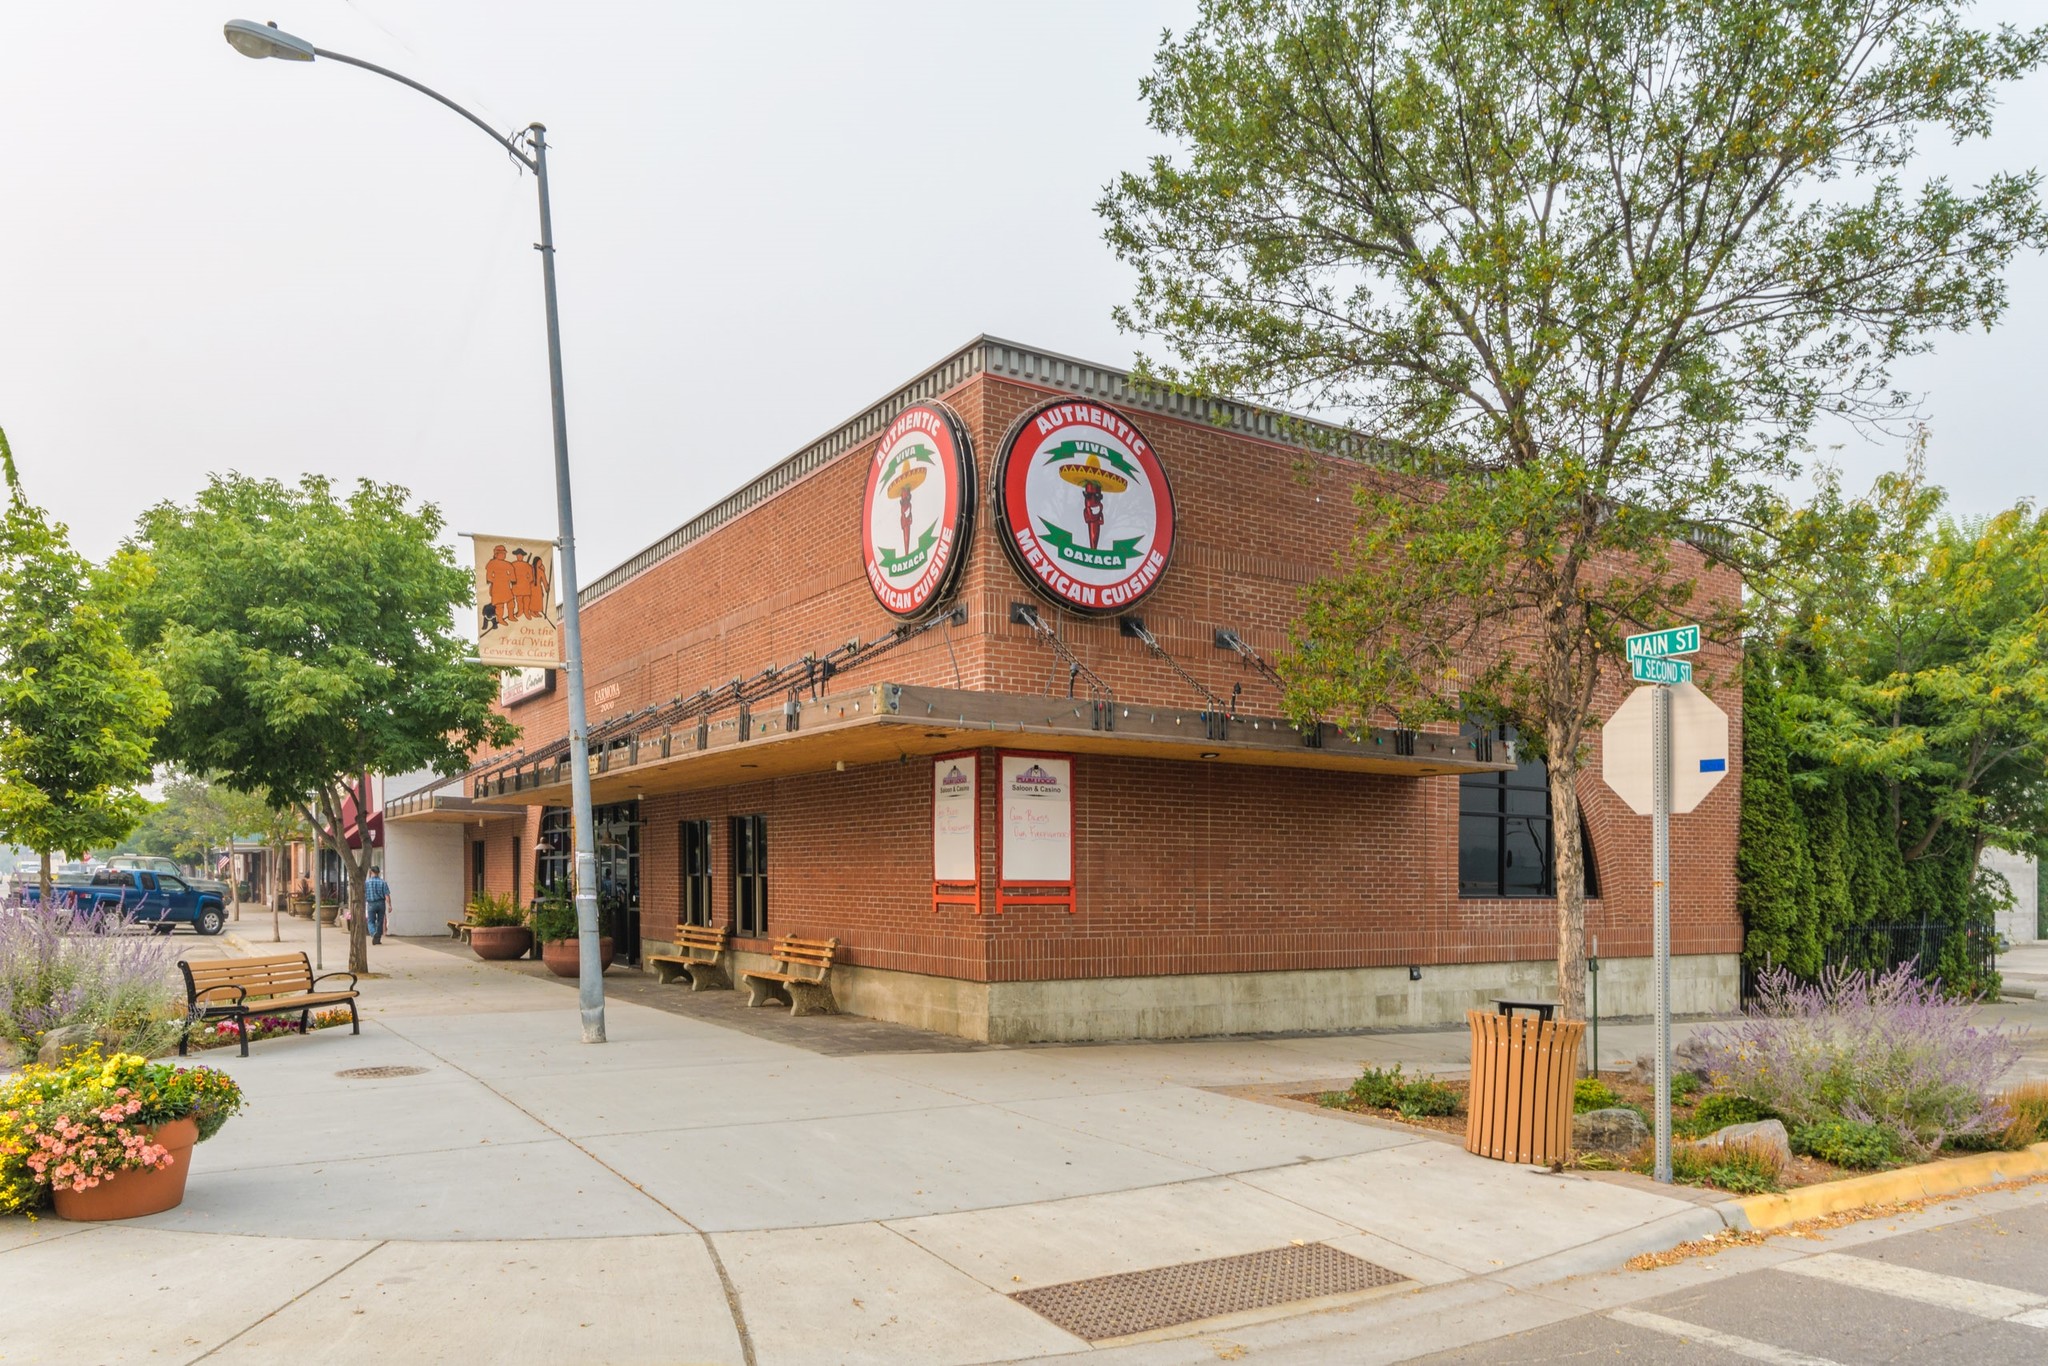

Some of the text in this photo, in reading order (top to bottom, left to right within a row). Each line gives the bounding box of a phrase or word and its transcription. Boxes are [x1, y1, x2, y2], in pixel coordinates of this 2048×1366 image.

[876, 411, 941, 467] AUTHENTIC
[1036, 405, 1146, 456] AUTHENTIC
[895, 445, 916, 464] VIVA
[1074, 441, 1110, 457] VIVA
[891, 550, 925, 573] OAXACA
[1016, 527, 1164, 606] MEXICAN CUISINE
[1063, 547, 1121, 566] OAXACA
[868, 526, 953, 609] MEXICAN CUISINE
[500, 636, 554, 647] Trail With
[520, 626, 554, 636] On the
[484, 647, 512, 656] Lewis
[527, 649, 555, 658] Clark
[1630, 629, 1695, 658] MAIN ST
[1635, 657, 1689, 682] W SECOND ST
[1012, 784, 1033, 792] Saloon
